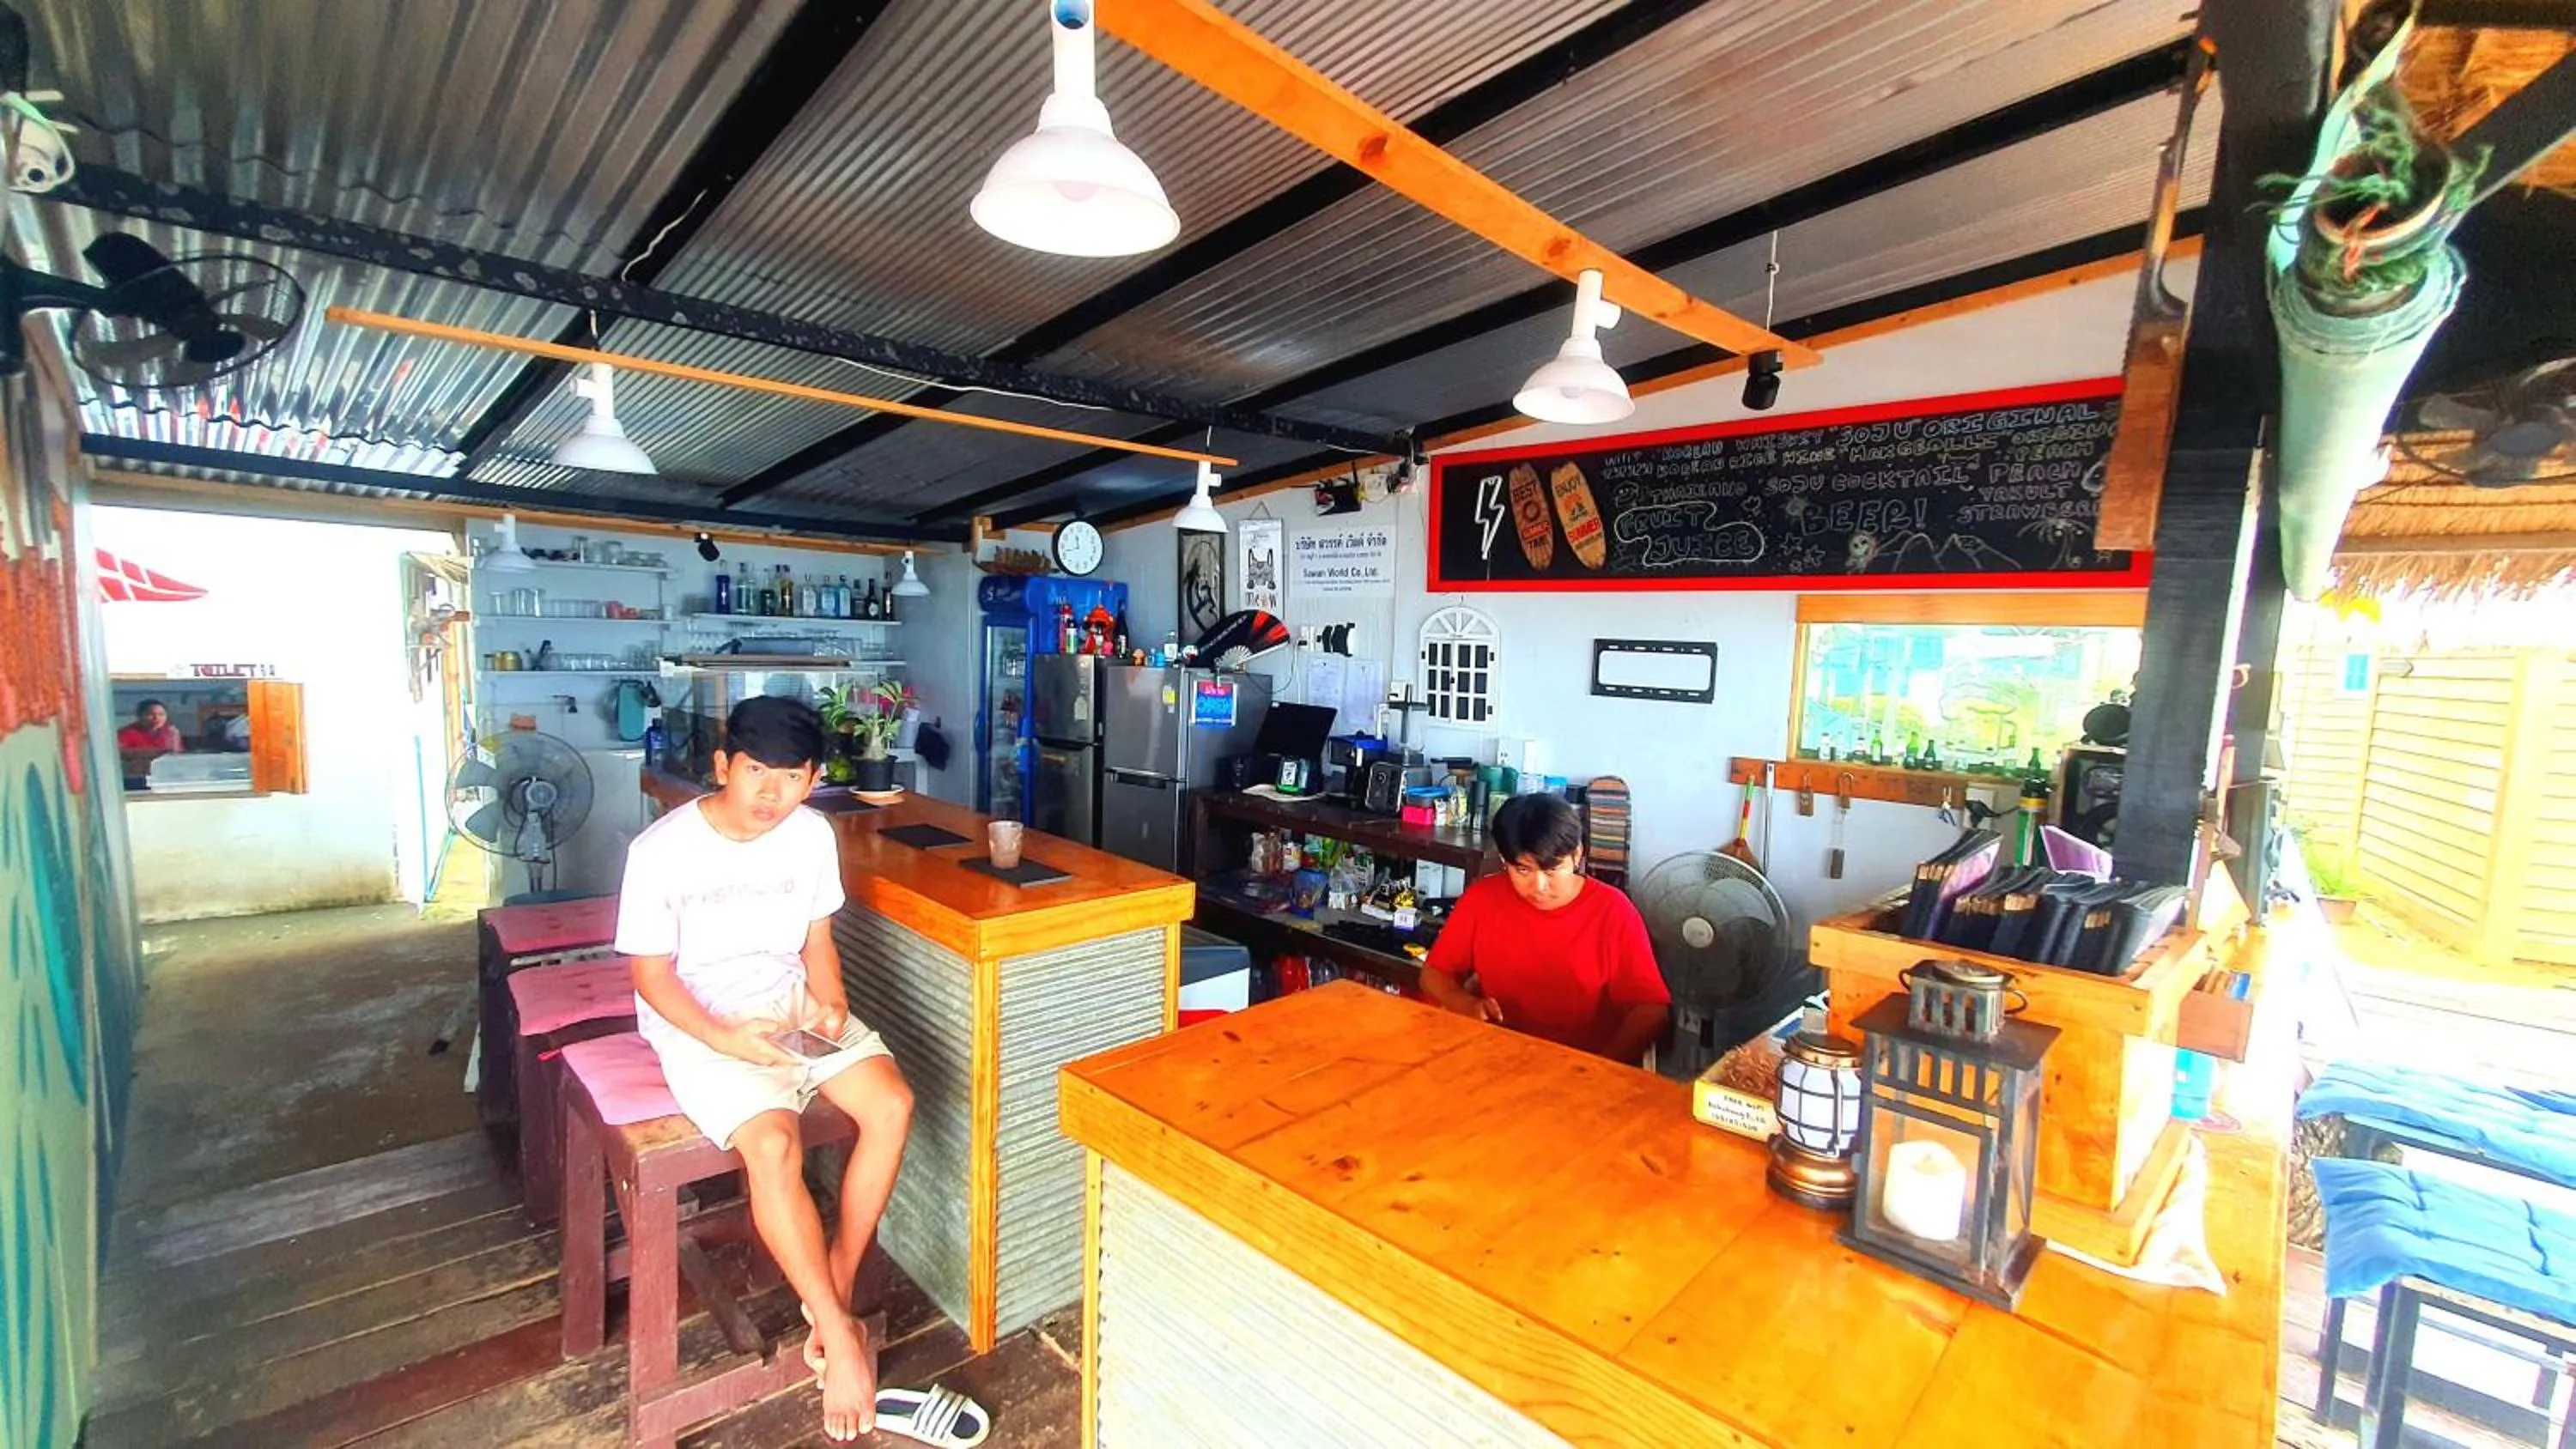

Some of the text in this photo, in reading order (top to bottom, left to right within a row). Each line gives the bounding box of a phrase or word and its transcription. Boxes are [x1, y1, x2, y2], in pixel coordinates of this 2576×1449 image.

[1923, 403, 2099, 438] ORIGINAL
[2014, 440, 2094, 462] PEACH
[1656, 457, 1724, 478] KOREAN
[1831, 464, 1970, 492] COCKTAIL
[1989, 460, 2082, 485] PEACH
[1978, 482, 2073, 503] YAKULT
[1619, 505, 1707, 540] FRUIT
[1653, 529, 1755, 560] JUICE
